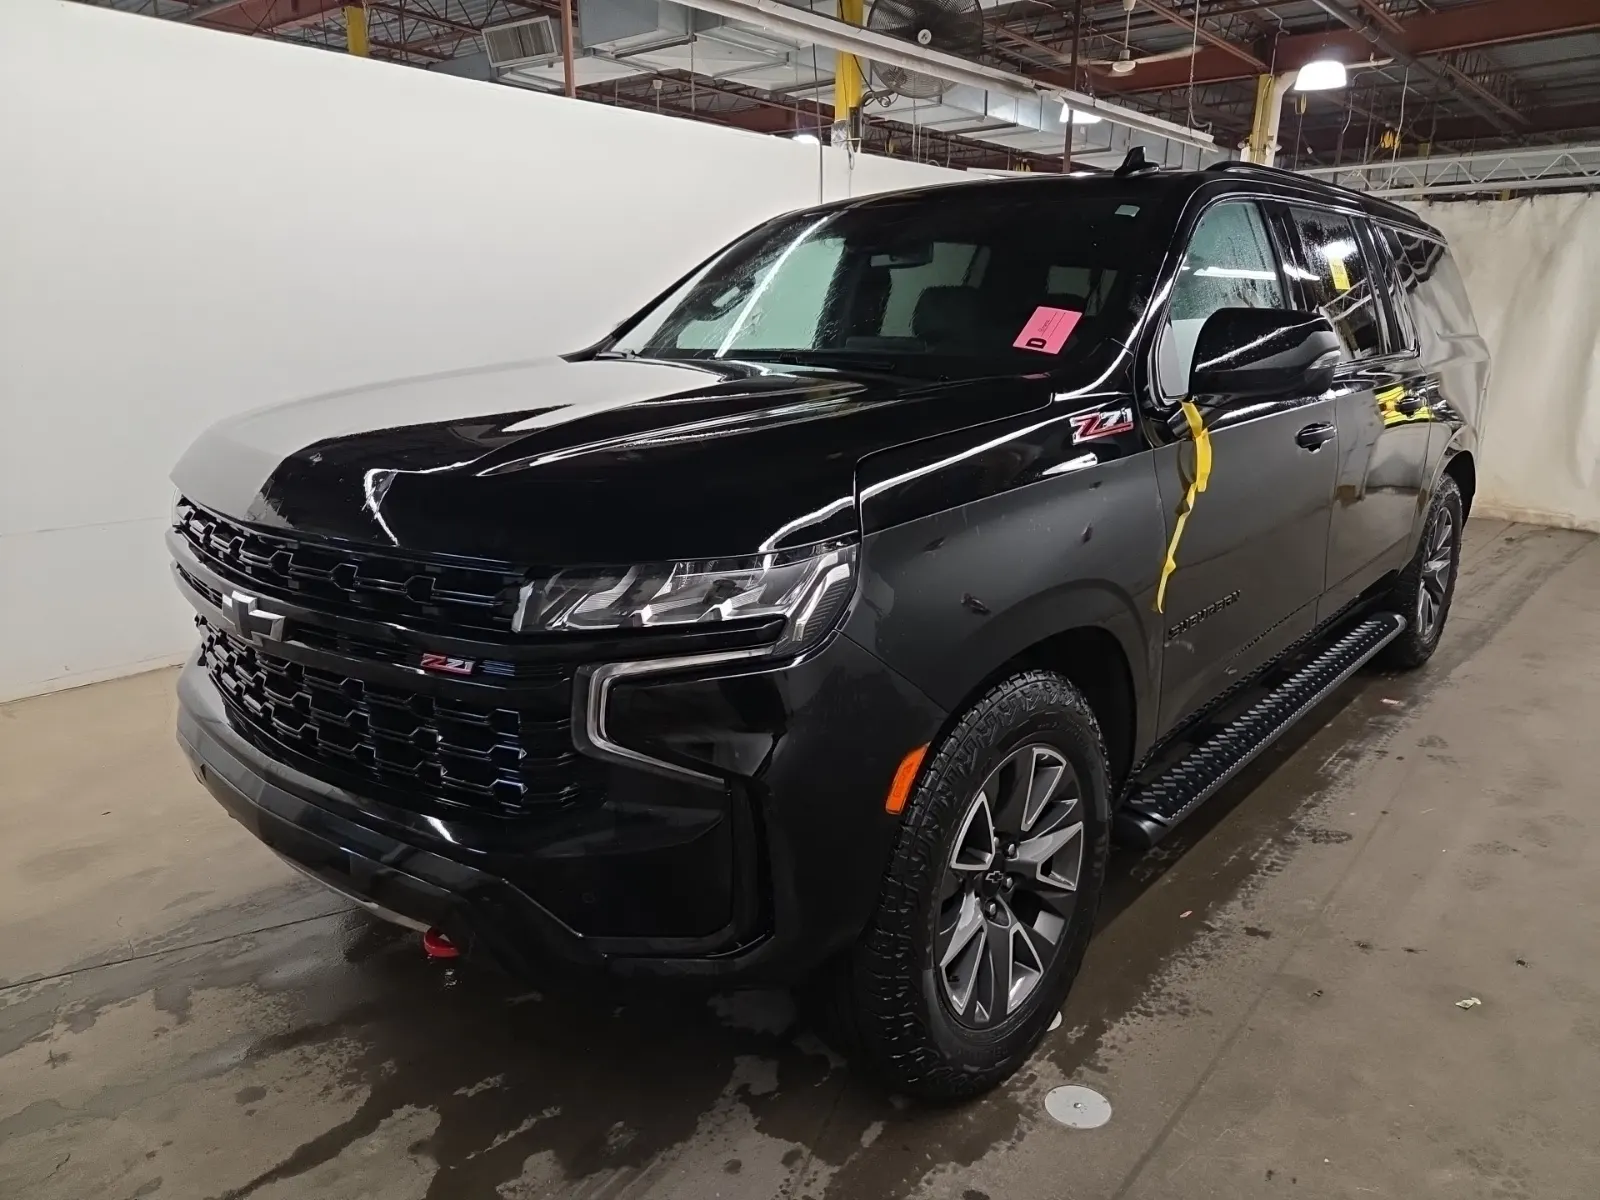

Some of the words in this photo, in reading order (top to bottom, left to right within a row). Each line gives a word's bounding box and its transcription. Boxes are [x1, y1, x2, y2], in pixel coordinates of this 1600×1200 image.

[1025, 337, 1047, 349] D
[1069, 407, 1134, 445] Z71
[1168, 589, 1241, 640] SUBURBAN
[420, 653, 475, 675] Z71
